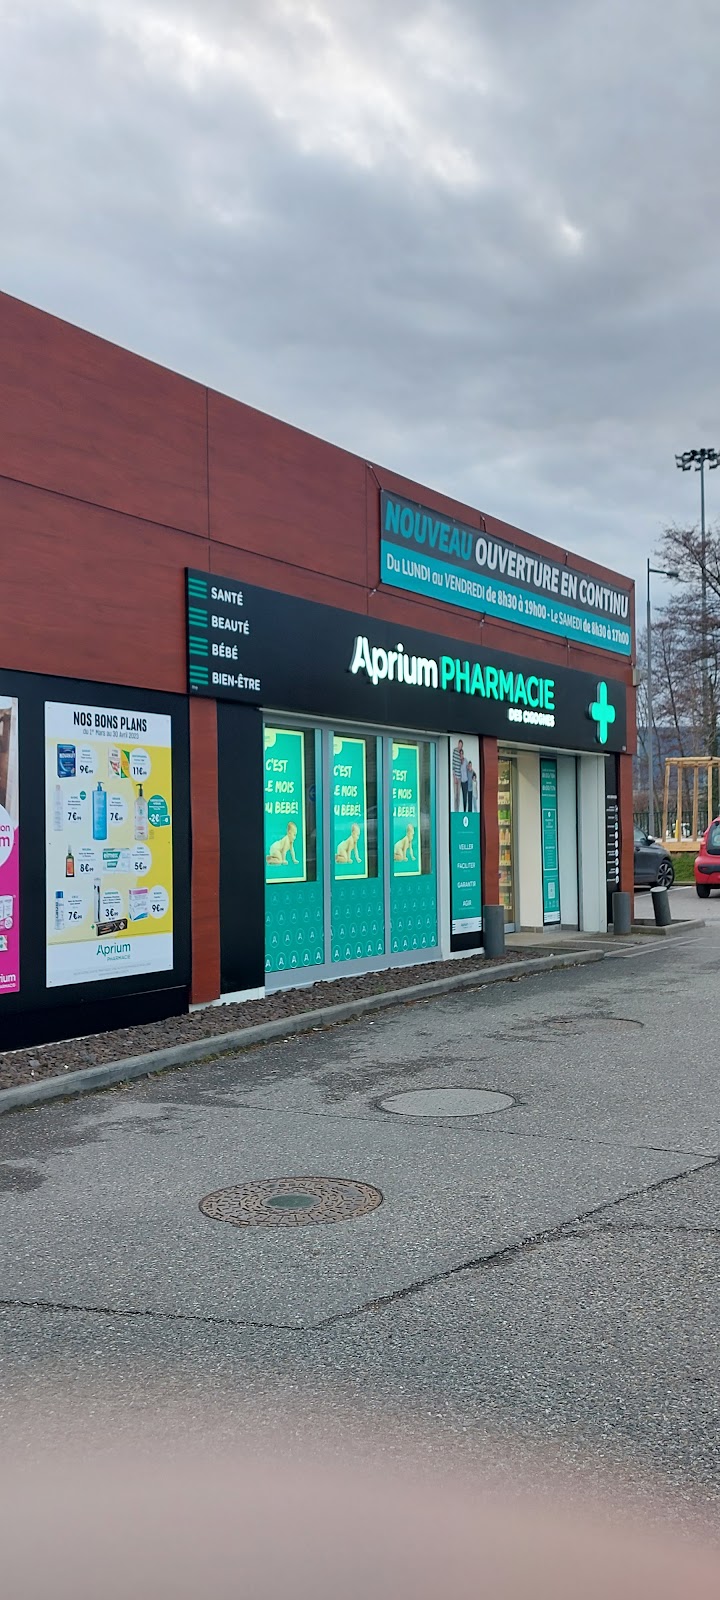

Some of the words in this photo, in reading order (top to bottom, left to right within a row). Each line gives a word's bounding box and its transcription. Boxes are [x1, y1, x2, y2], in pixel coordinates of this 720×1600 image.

[385, 500, 473, 561] NOUVEAU
[475, 538, 558, 594] OUVERTURE
[561, 570, 578, 600] EN
[579, 578, 629, 618] CONTINU
[211, 586, 244, 606] SANTÉ
[386, 553, 400, 573] Du
[402, 558, 431, 581] LUNDI
[432, 572, 443, 586] au
[445, 573, 485, 599] VENDREDI
[486, 585, 497, 604] de
[498, 590, 517, 610] 8h30
[518, 594, 524, 611] à
[524, 600, 546, 619] 19h00
[551, 609, 558, 624] Le
[559, 612, 582, 629] SAMEDI
[582, 618, 591, 633] de
[591, 622, 606, 638] 8h30
[607, 624, 611, 639] à
[612, 628, 629, 645] 17h00
[211, 615, 249, 635] BEAUTÉ
[211, 644, 238, 660] BÉBÉ
[350, 635, 438, 688] Aprium
[440, 655, 555, 710] PHARMACIE
[74, 711, 92, 727] NOS
[95, 714, 118, 730] BONS
[121, 717, 147, 732] PLANS
[266, 758, 288, 773] C'EST
[334, 764, 352, 778] C'EST
[275, 781, 294, 793] MOIS
[342, 785, 357, 798] MOIS
[398, 788, 412, 800] MOIS
[275, 799, 298, 815] BÉBÉ!
[341, 802, 361, 817] BÉBÉ!
[96, 942, 131, 956] Aprium
